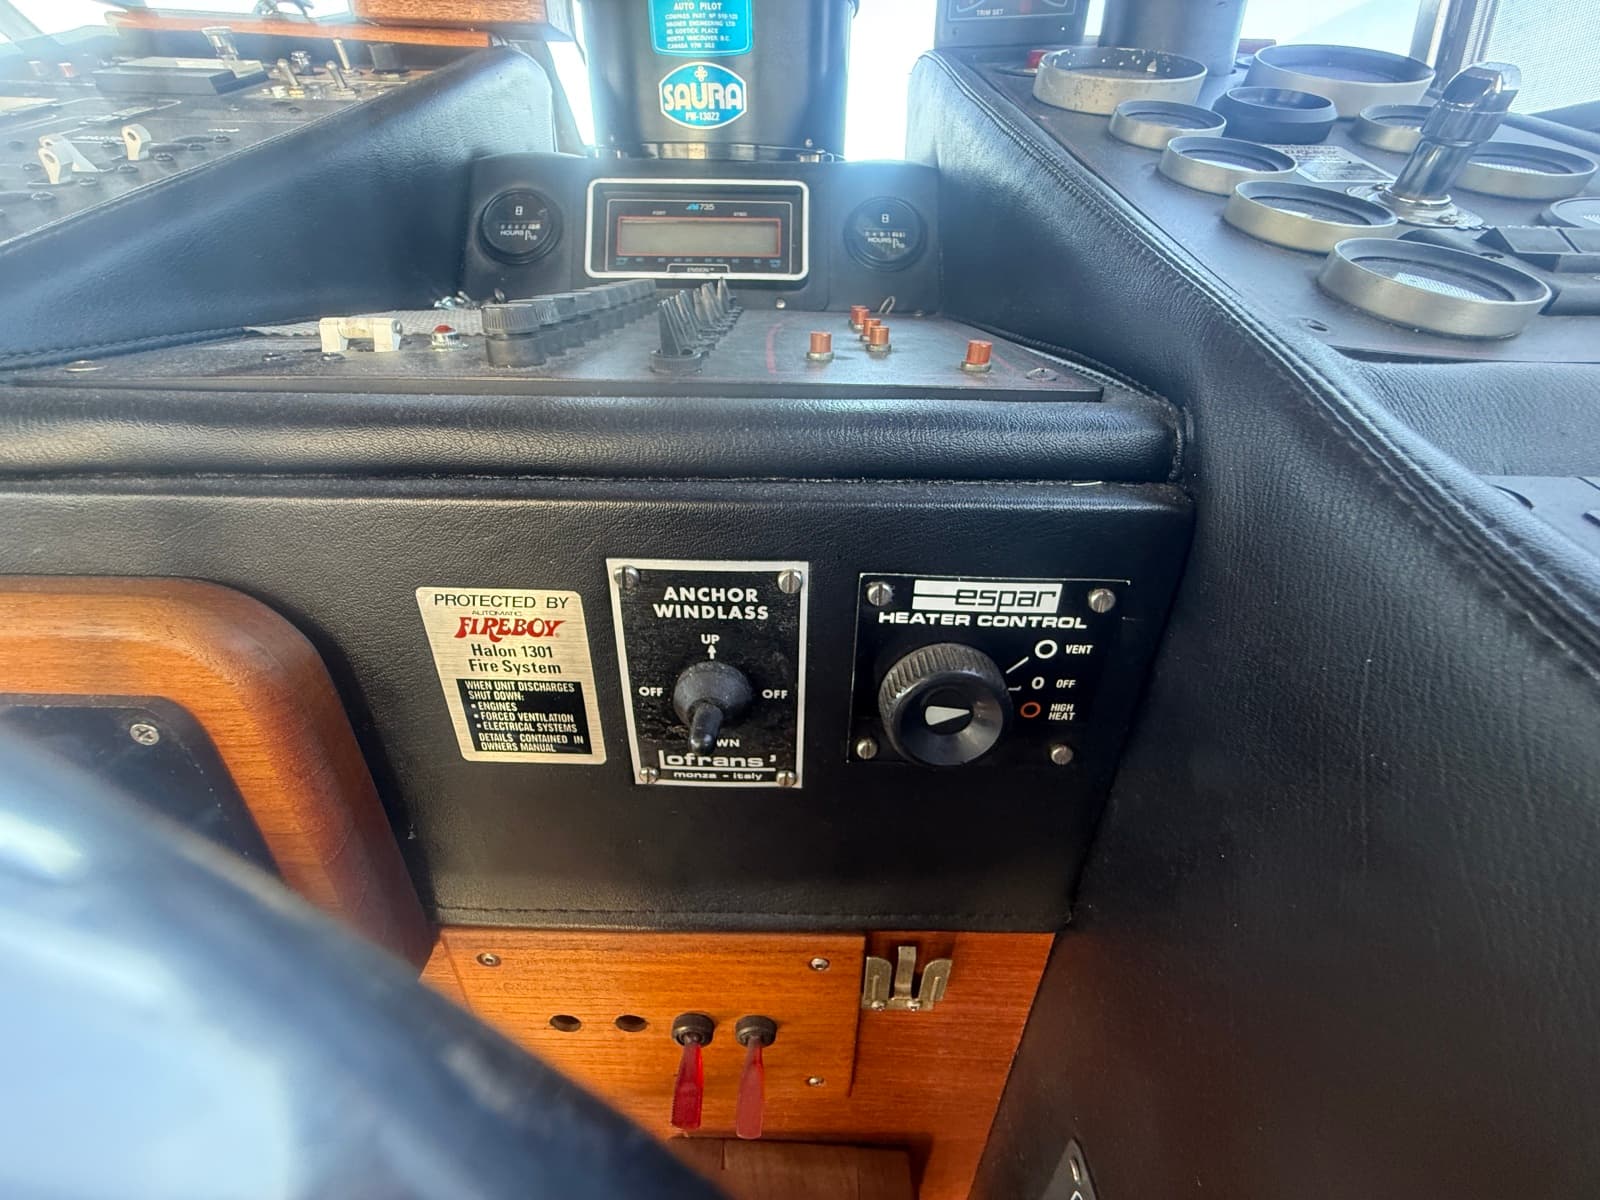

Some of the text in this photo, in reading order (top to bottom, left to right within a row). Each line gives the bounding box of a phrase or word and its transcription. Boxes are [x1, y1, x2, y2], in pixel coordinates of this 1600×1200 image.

[673, 2, 723, 11] AUTO PILOT
[992, 8, 1004, 16] SET
[663, 82, 743, 111] SAURA
[867, 236, 892, 244] HOURS
[663, 586, 758, 603] ANCHOR
[434, 593, 569, 609] PROTECTED BY
[955, 588, 1058, 614] espar
[653, 603, 769, 620] WINDLASS
[878, 611, 1088, 629] HEATER CONTROL
[454, 616, 567, 643] FIREBOY
[700, 633, 720, 645] UP
[470, 643, 553, 659] Halon 1301
[1065, 644, 1093, 656] VENT
[468, 658, 562, 675] Fire System
[465, 680, 575, 693] WHEN UNIT DISCHARGES
[1055, 679, 1077, 689] OFF
[468, 690, 525, 701] SHUT DOWN:
[638, 686, 664, 697] OFF
[762, 689, 788, 700] OFF
[478, 701, 518, 712] ENGINES
[1050, 703, 1075, 713] HIGH
[480, 711, 574, 723] FORCED VENTILATION
[1048, 711, 1076, 721] HEAT
[483, 721, 578, 733] ELECTRICAL SYSTEMS
[478, 732, 584, 744] DETAILS CONTAINED IN
[481, 742, 557, 753] OWNERS MANUAL
[673, 771, 717, 780] monza
[732, 771, 763, 781] italy
